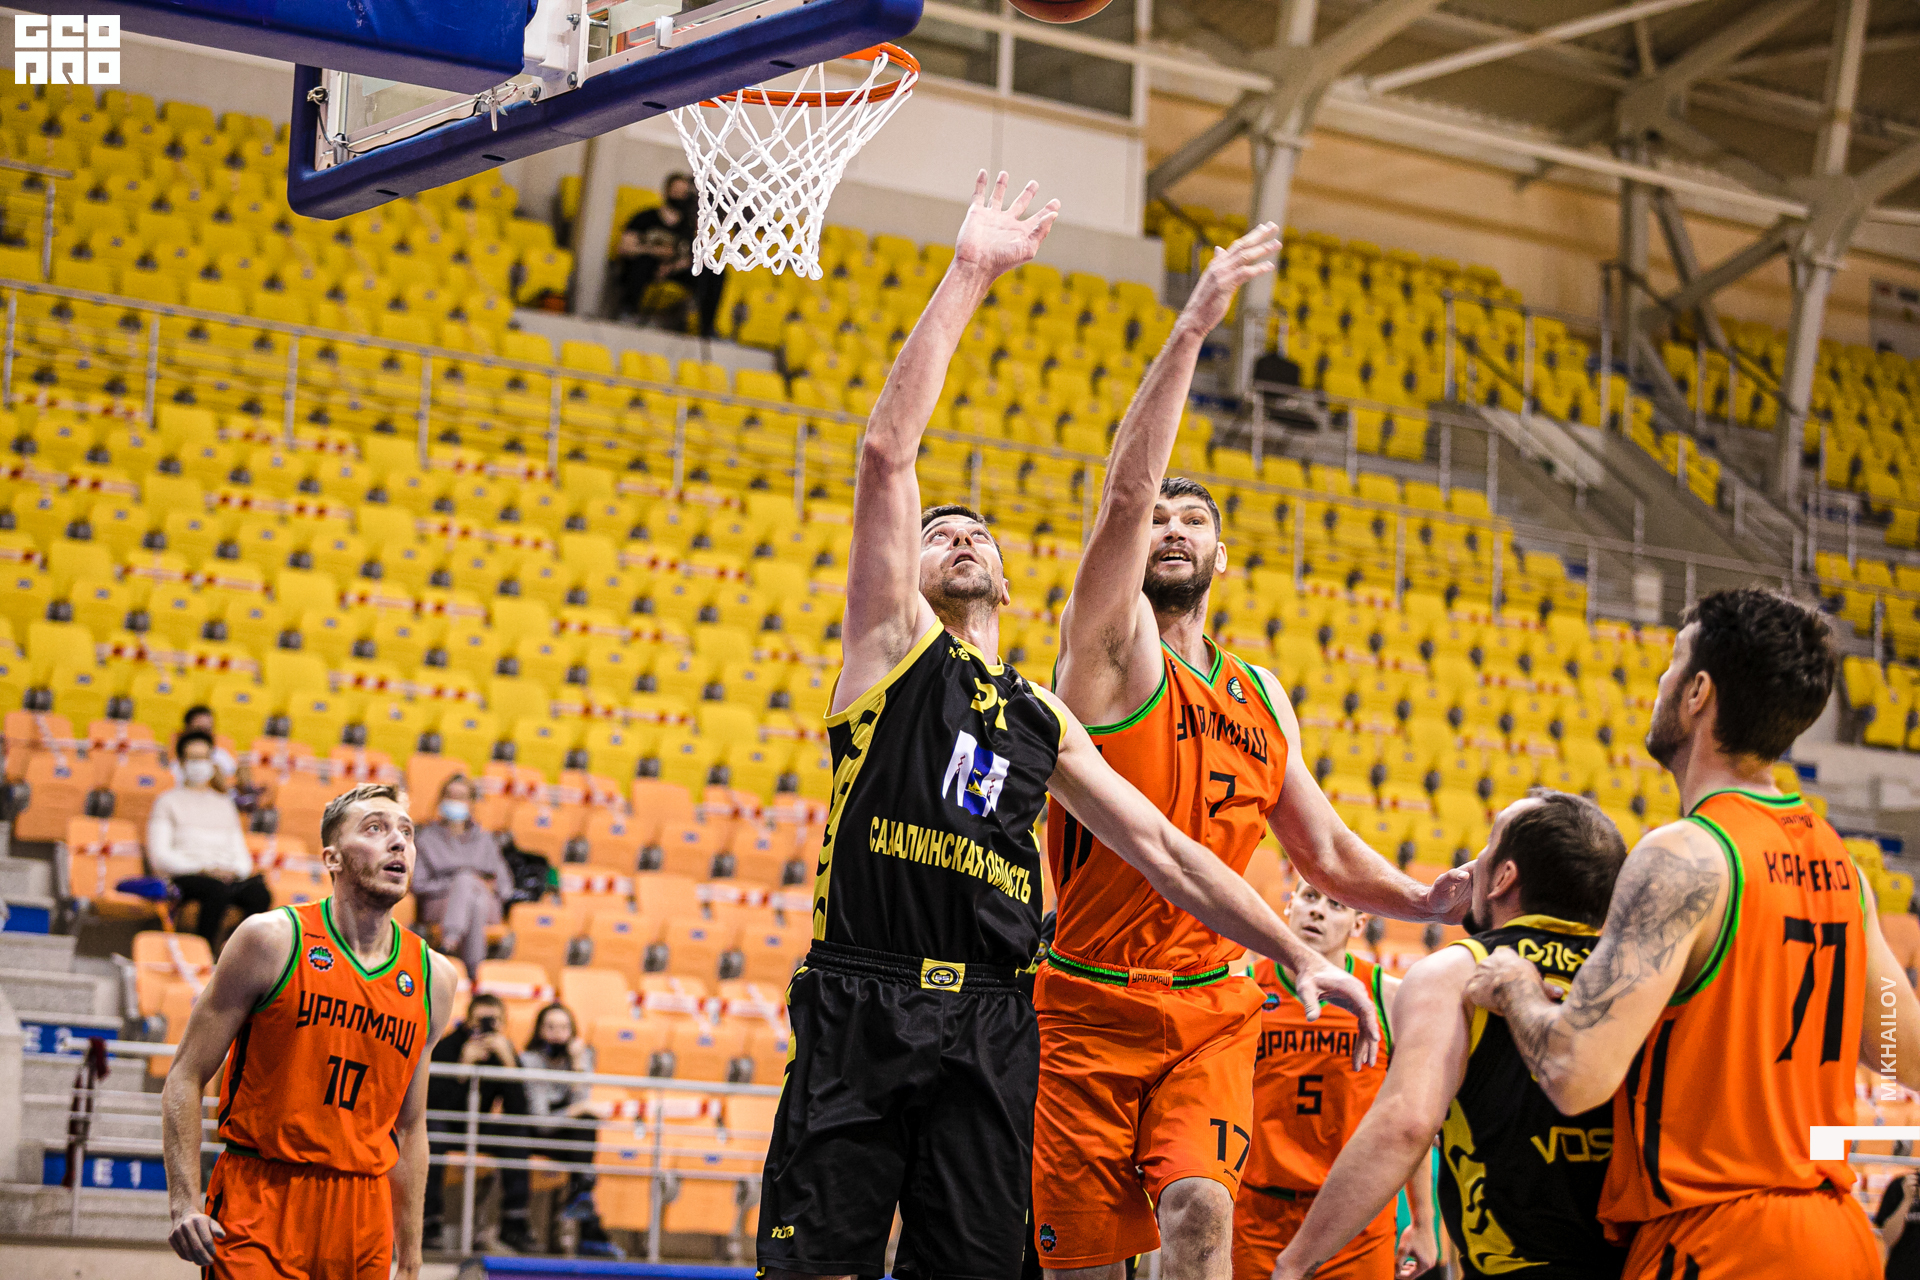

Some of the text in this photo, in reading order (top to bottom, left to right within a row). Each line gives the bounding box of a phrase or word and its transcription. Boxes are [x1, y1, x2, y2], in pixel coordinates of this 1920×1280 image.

[869, 816, 985, 879] САХАЛИНСКАЯ
[1131, 973, 1170, 987] УРАЛМАШ
[1774, 916, 1849, 1067] 71
[296, 990, 417, 1060] УРАЛМАШ
[1255, 1030, 1358, 1063] УРАЛМА
[323, 1055, 370, 1112] 10
[1296, 1075, 1324, 1116] 5
[92, 1157, 114, 1187] E
[1209, 1117, 1251, 1173] 17
